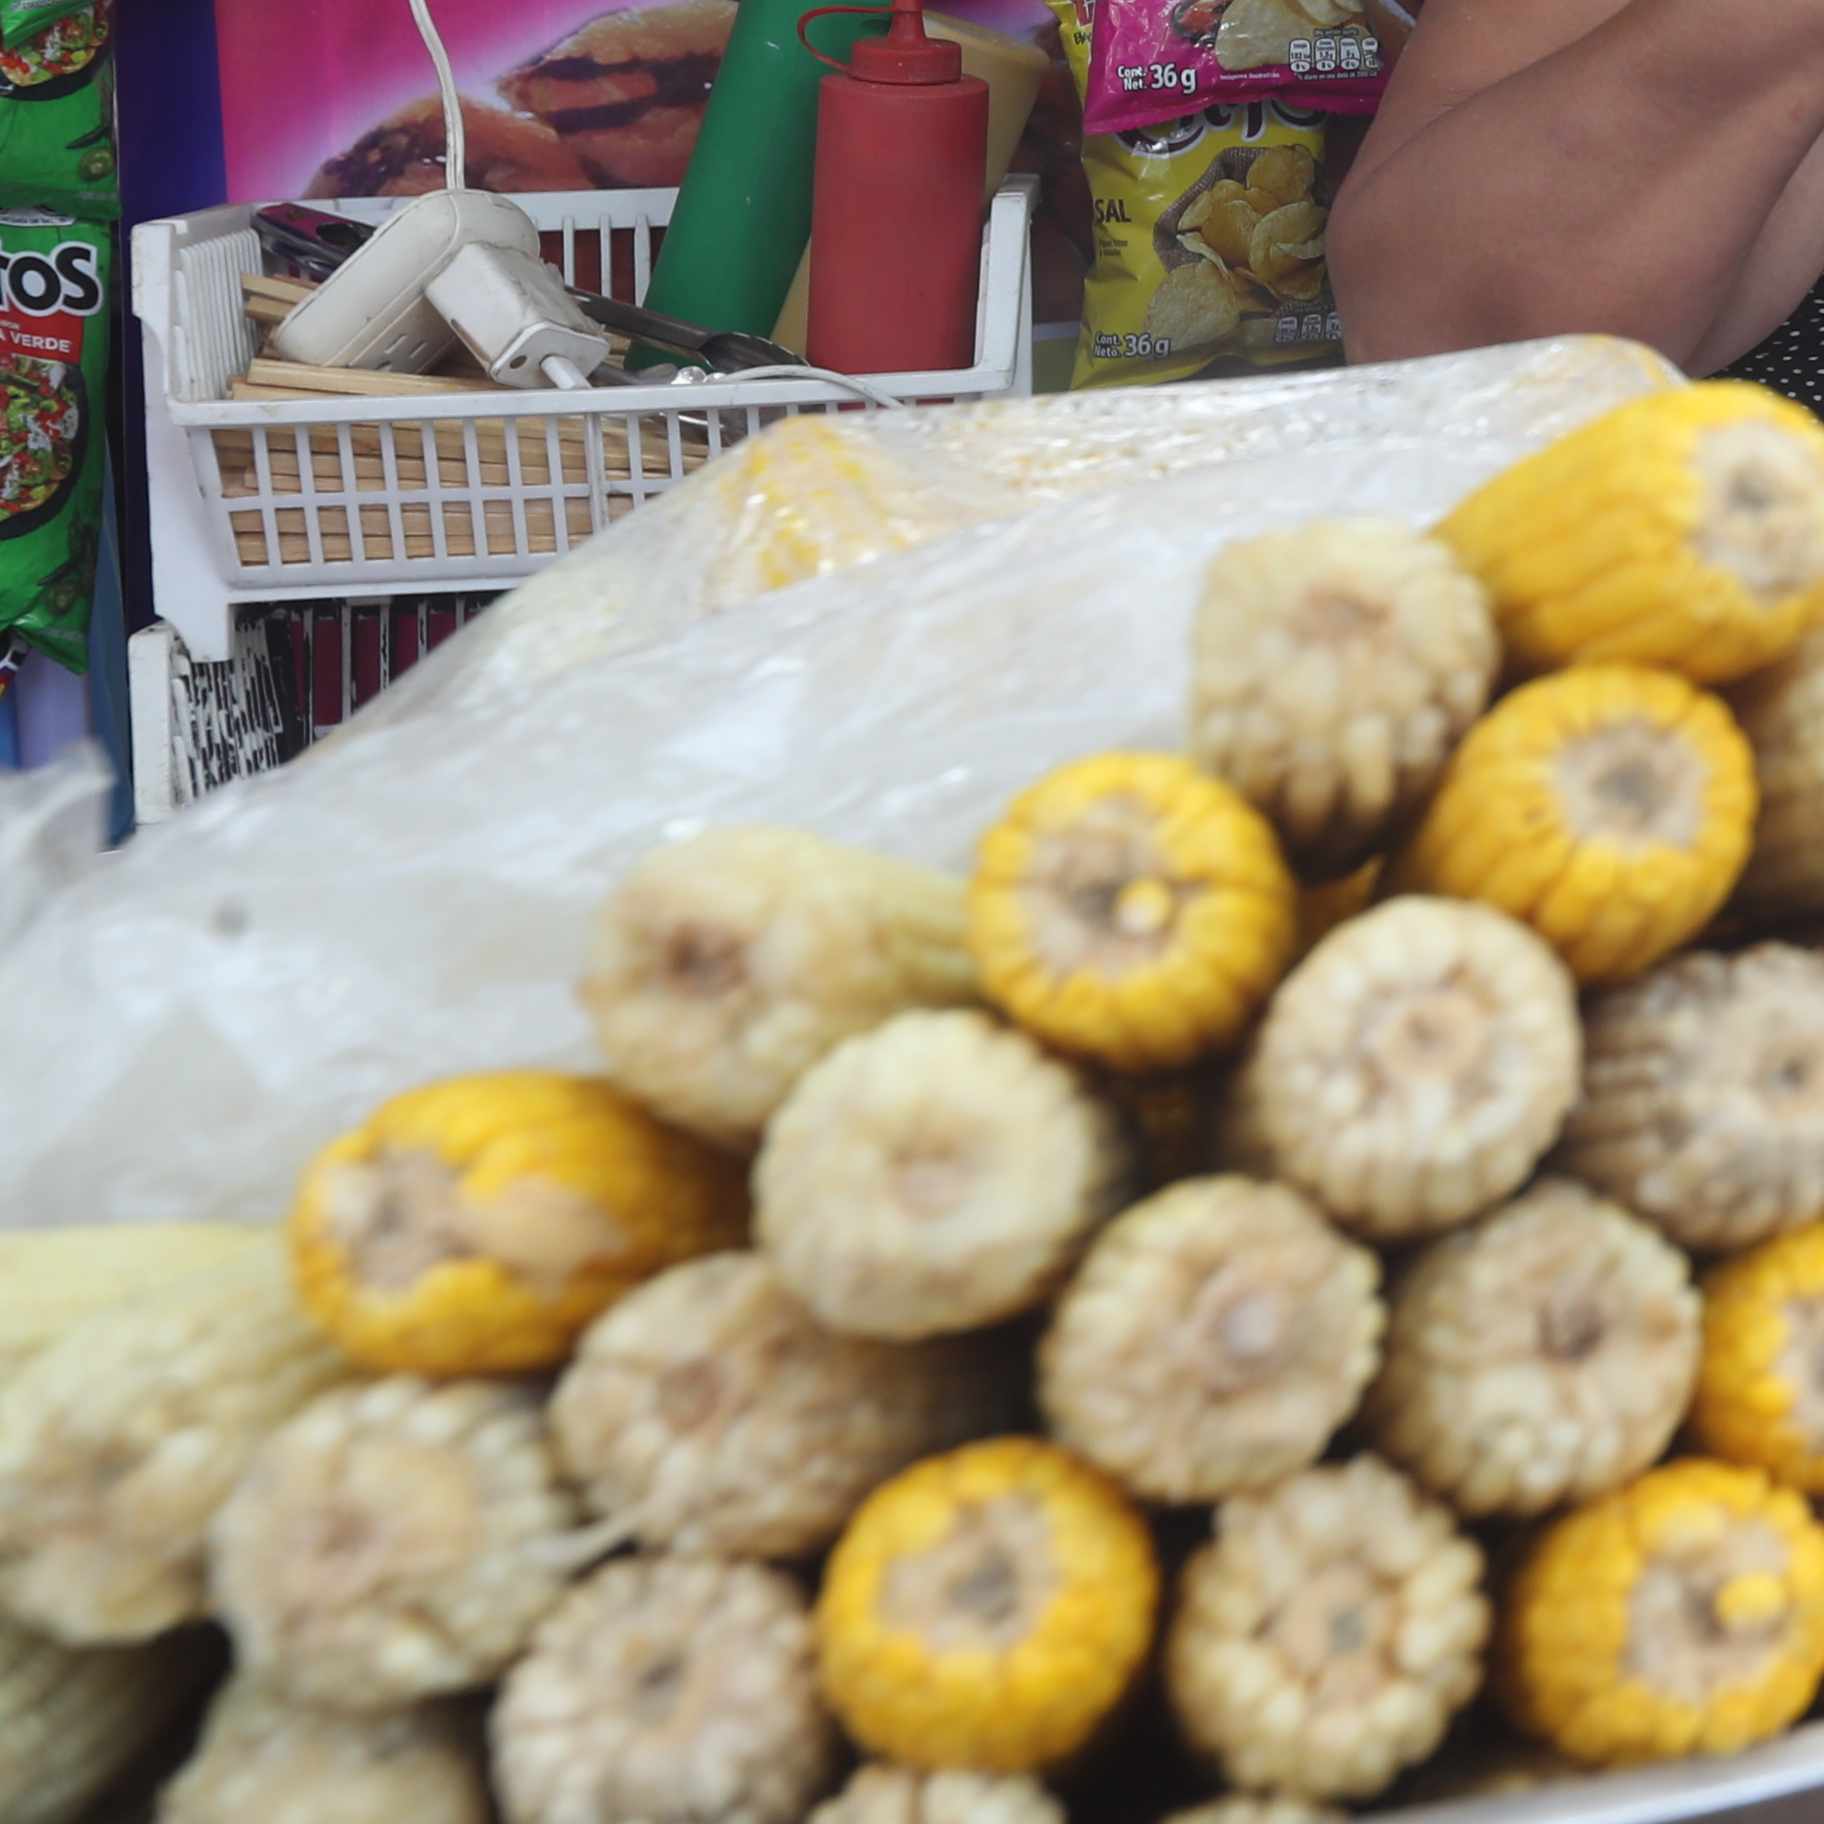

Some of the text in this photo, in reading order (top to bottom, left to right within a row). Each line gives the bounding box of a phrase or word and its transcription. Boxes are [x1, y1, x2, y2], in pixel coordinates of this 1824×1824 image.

[1117, 65, 1147, 79] Cont.
[1150, 64, 1197, 94] 36 g
[1123, 78, 1147, 91] Net.
[1095, 198, 1132, 223] SAL
[11, 330, 72, 354] VERDE
[1096, 333, 1121, 345] Cont.
[1125, 333, 1171, 358] 36 g
[1093, 345, 1121, 357] Neto.
